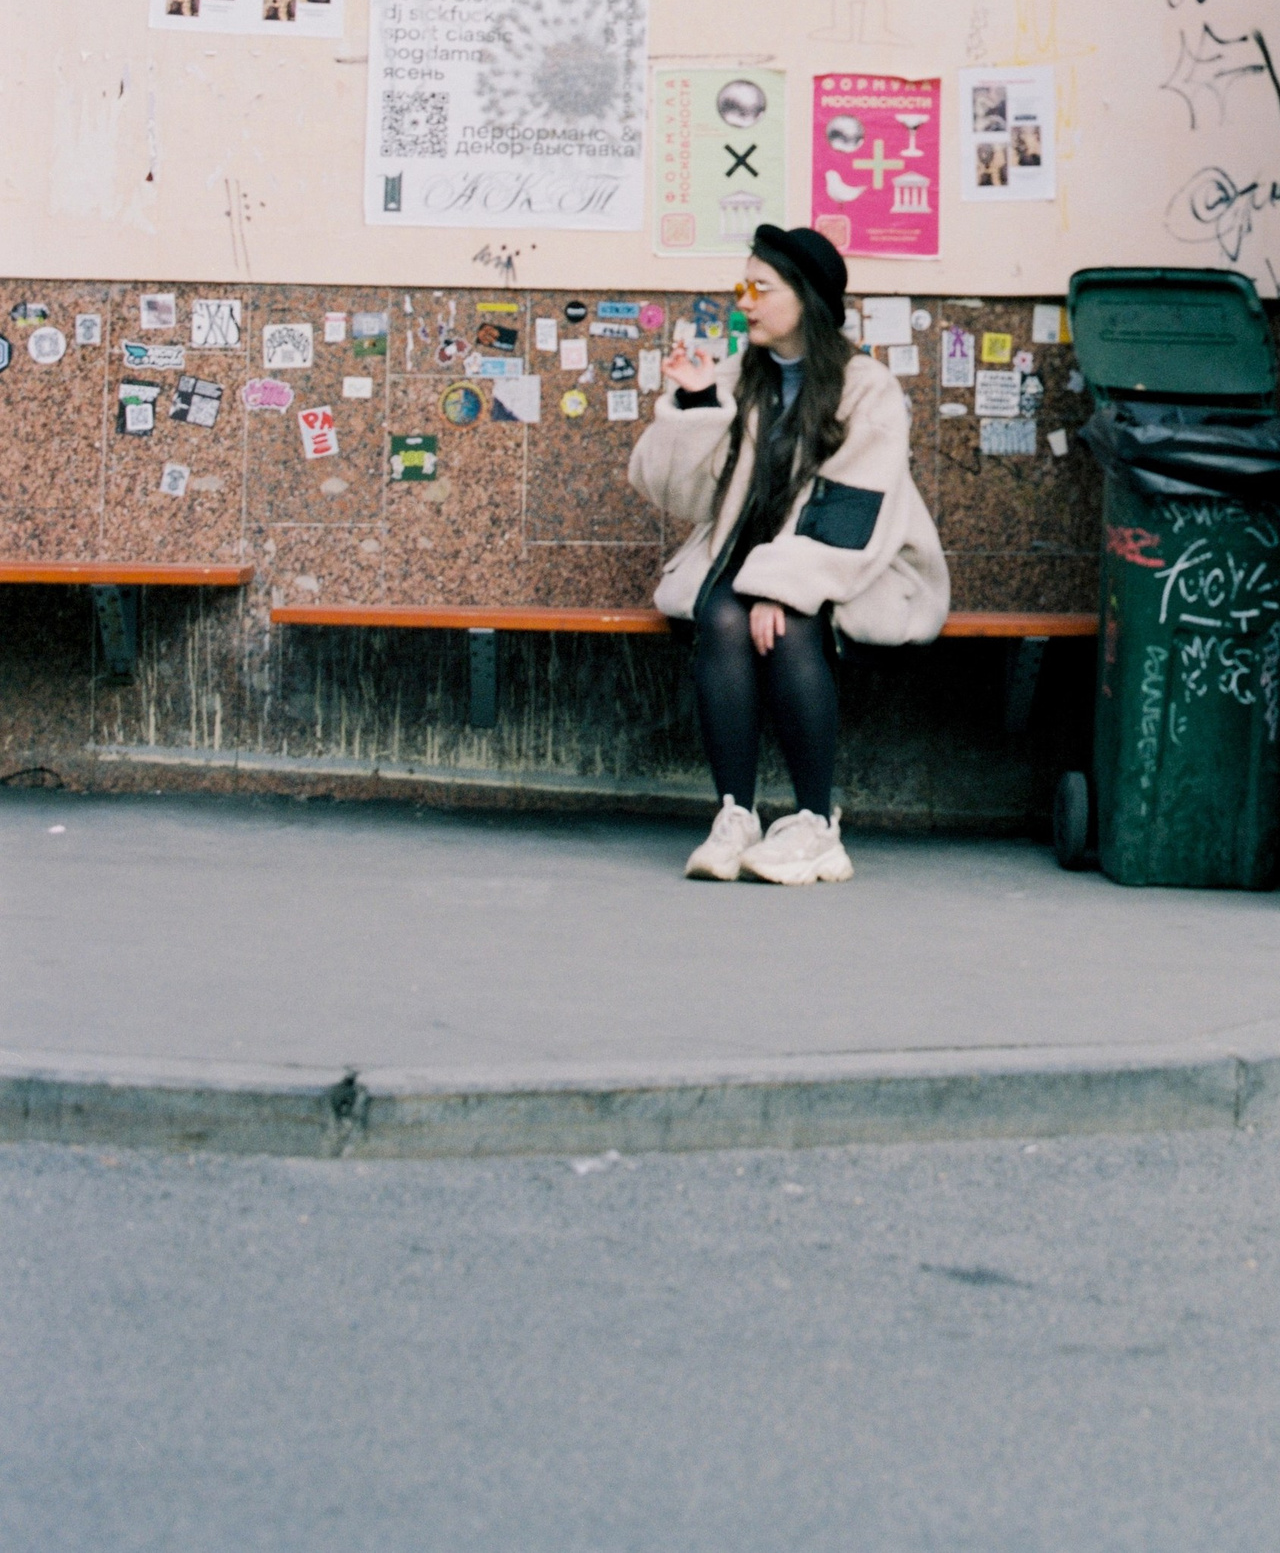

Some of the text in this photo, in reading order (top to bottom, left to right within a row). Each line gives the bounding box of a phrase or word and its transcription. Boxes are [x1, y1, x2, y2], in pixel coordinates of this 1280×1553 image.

[383, 65, 446, 82] ясень
[820, 77, 933, 92] ФОРМУЛА
[462, 124, 607, 145] перформанс
[664, 79, 677, 205] ФОРМУЛА
[680, 78, 692, 204] МОСКОВСКОСТИ
[455, 140, 636, 159] декор-выставка
